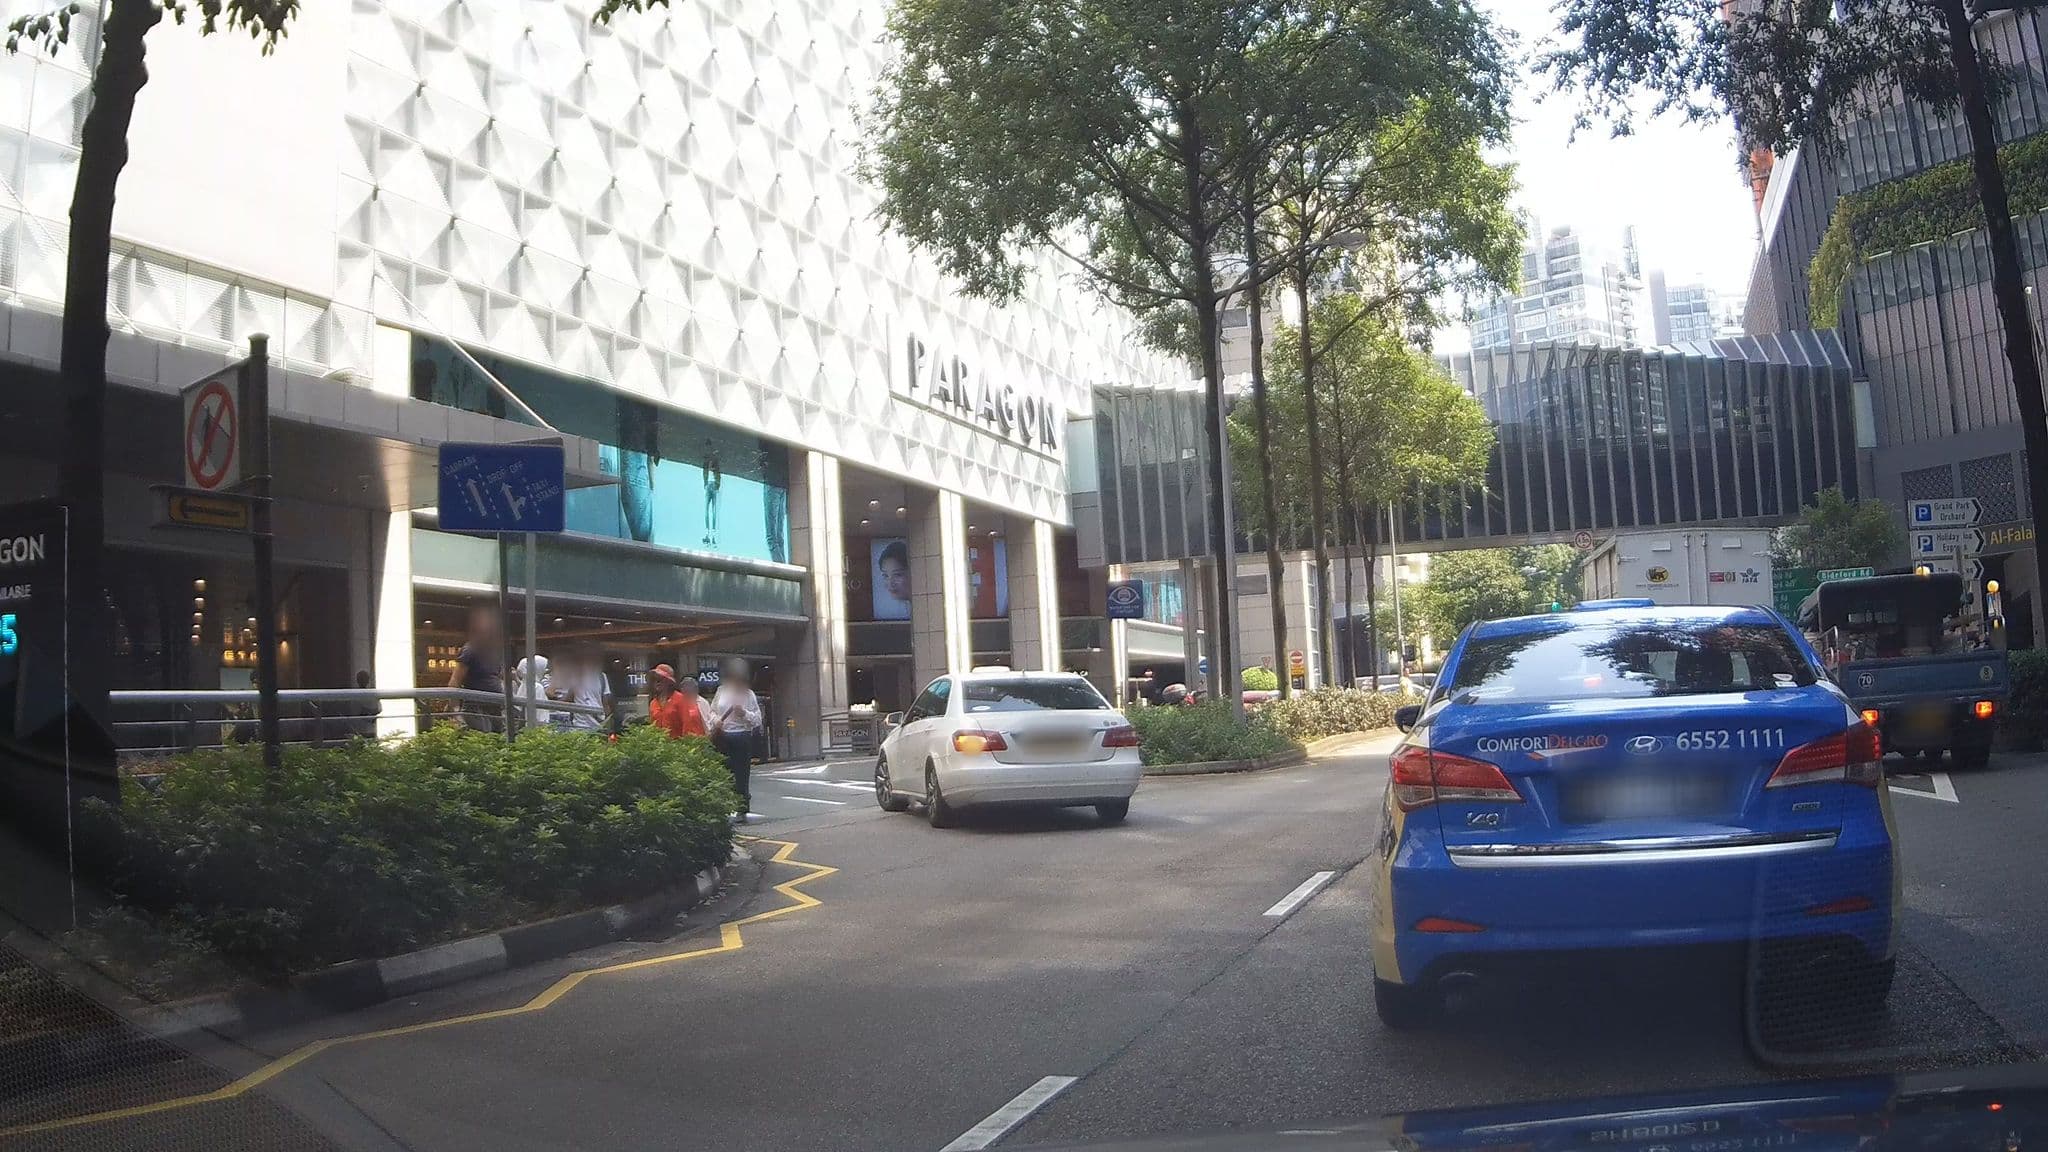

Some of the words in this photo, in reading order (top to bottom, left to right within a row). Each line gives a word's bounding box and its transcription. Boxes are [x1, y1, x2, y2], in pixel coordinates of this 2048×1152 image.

[907, 331, 1061, 452] PARAGON
[1934, 502, 1953, 510] Grand
[1956, 501, 1970, 510] Park
[1940, 512, 1966, 521] Orchard
[1936, 533, 1959, 542] Holiday
[1990, 525, 2035, 545] Al-Fala
[0, 614, 17, 655] 5
[699, 671, 720, 682] ASS
[1861, 675, 1872, 685] 70
[1676, 730, 1730, 750] 6552
[1736, 728, 1785, 748] 1111
